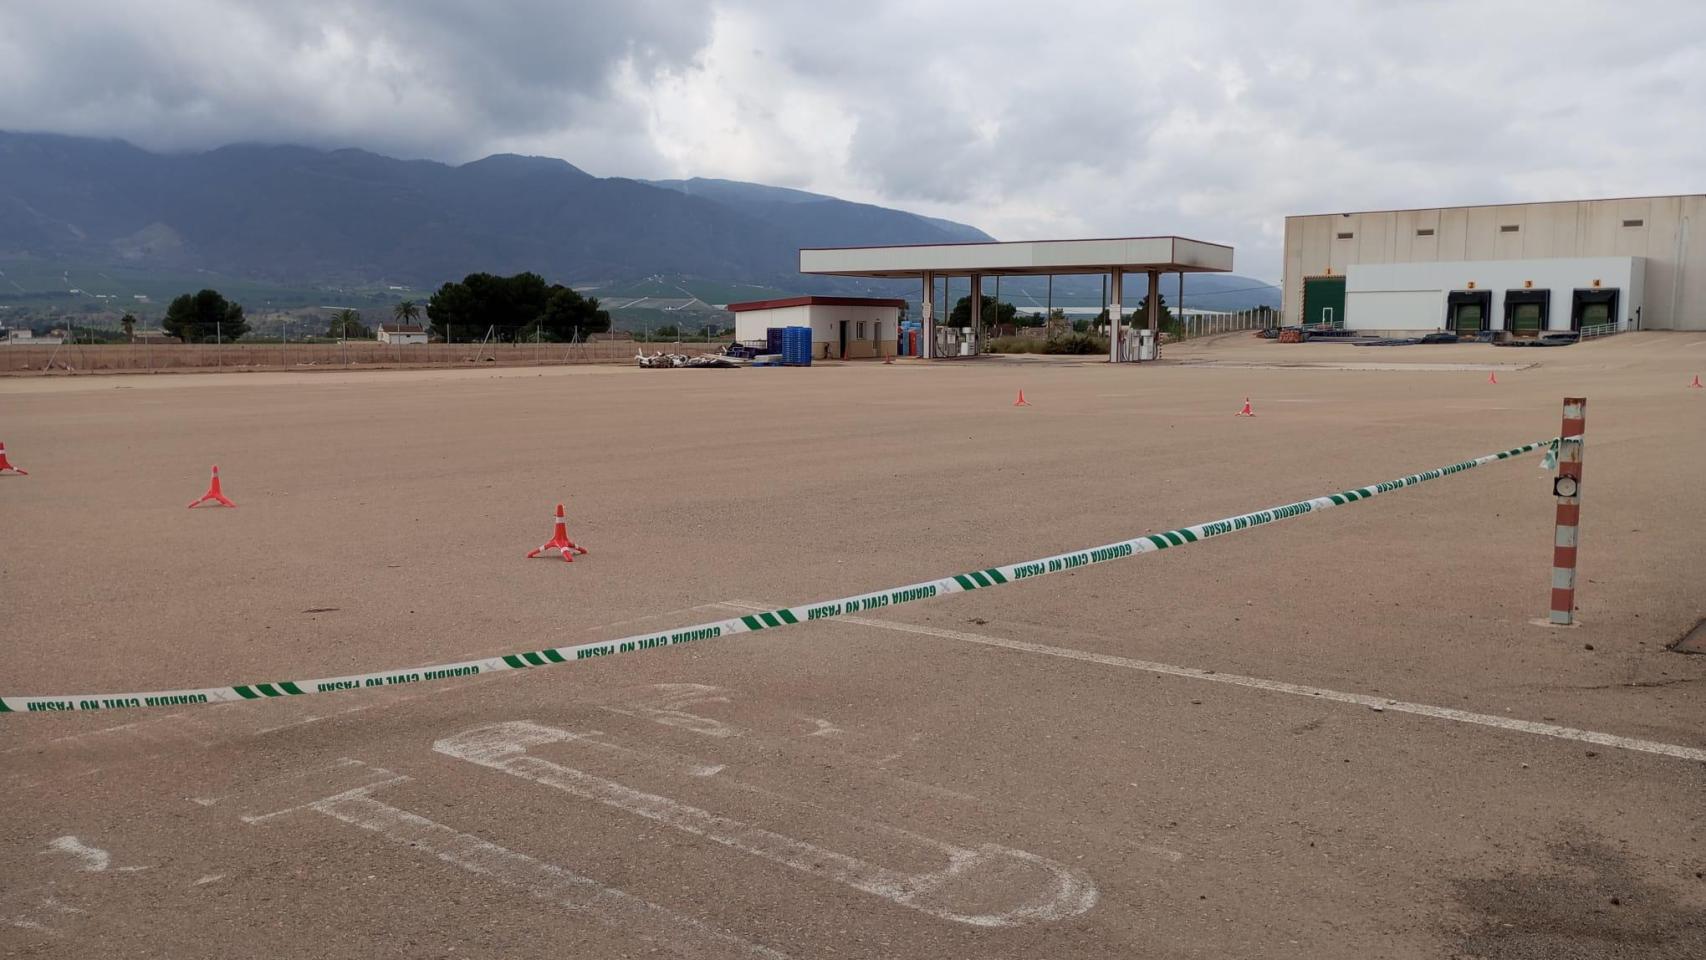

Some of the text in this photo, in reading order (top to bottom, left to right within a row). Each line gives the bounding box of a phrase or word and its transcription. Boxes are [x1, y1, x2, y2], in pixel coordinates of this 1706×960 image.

[1201, 502, 1312, 537] GUARDIA CIVIL NO PASAR
[1014, 543, 1133, 580] GUARDIA CIVIL NO PASAR
[861, 594, 888, 610] CIVIL
[891, 584, 937, 605] GUARDIA
[638, 635, 668, 649] CIVIL
[671, 626, 721, 644] GUARDIA
[386, 673, 420, 684] CIVIL
[103, 697, 140, 708] CIVIL
